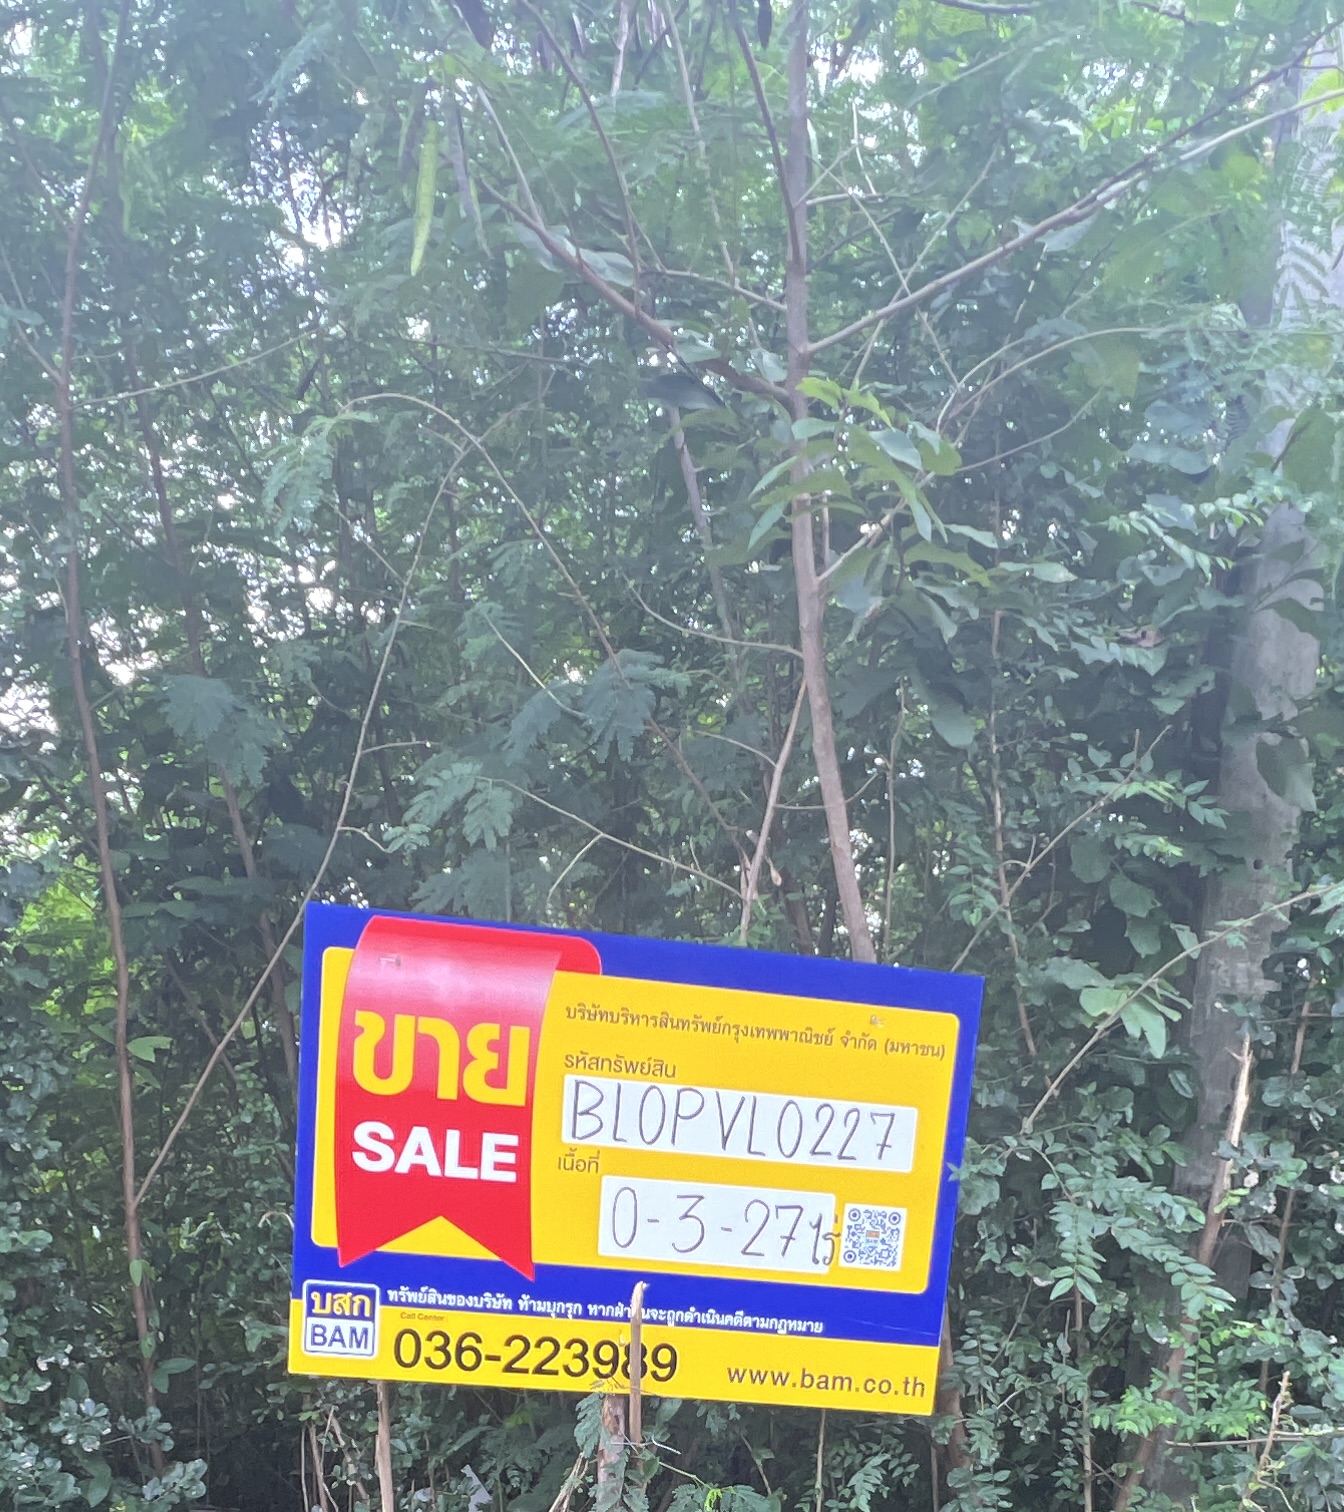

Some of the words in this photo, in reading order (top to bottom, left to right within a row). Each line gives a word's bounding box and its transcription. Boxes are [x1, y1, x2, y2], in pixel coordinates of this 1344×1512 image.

[565, 1004, 834, 1048] บริษัทบริหารสินทรัพย์กรุงเทพพาณิชย์
[840, 1031, 878, 1052] จำกัด
[884, 1041, 946, 1061] (มหาชน)
[353, 1010, 531, 1107] ขาย
[564, 1050, 678, 1079] รหัสทรัพย์สิน
[352, 1120, 520, 1183] SALE
[557, 1147, 601, 1175] เนื้อที่
[310, 1289, 371, 1318] บสก
[387, 1285, 514, 1311] ทรัพย์สินของบริษัท
[310, 1323, 370, 1350] BAM
[727, 1367, 926, 1398] www.bam.co.th
